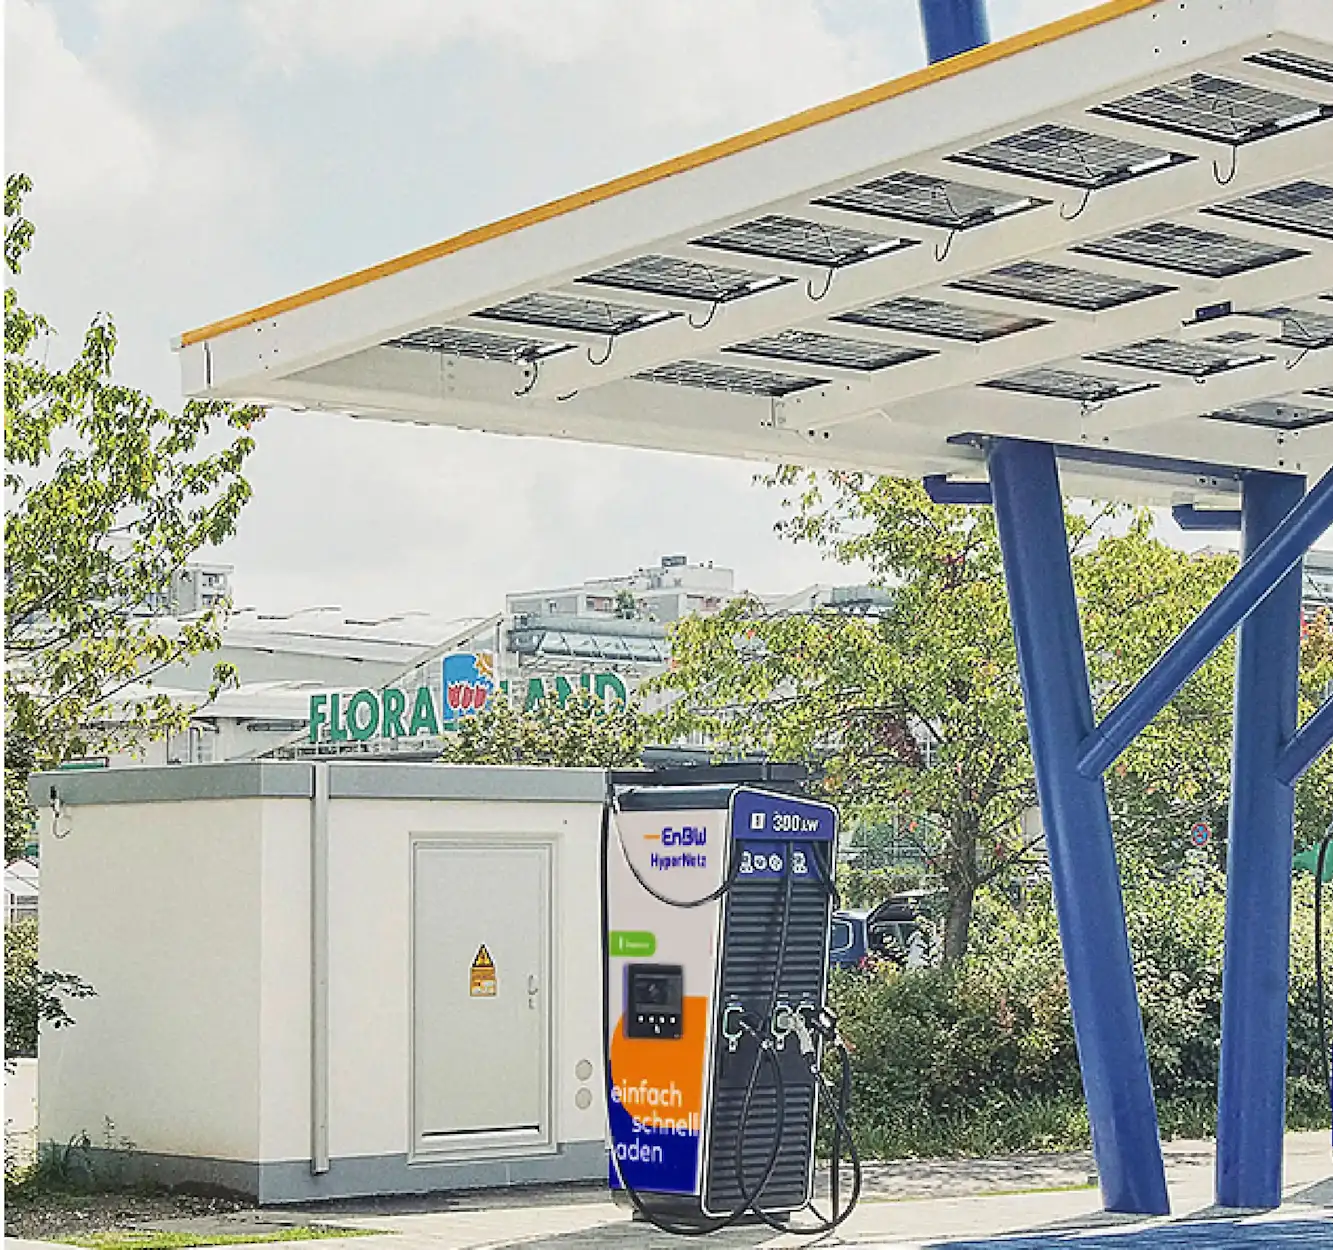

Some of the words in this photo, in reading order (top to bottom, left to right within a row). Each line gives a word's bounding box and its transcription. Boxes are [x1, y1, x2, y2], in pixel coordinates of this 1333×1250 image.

[308, 686, 440, 742] FLORA
[661, 826, 707, 846] EnBW
[650, 853, 707, 871] HyperNetz
[610, 1079, 683, 1108] einfach
[631, 1109, 700, 1137] schnell
[611, 1137, 664, 1164] aden
